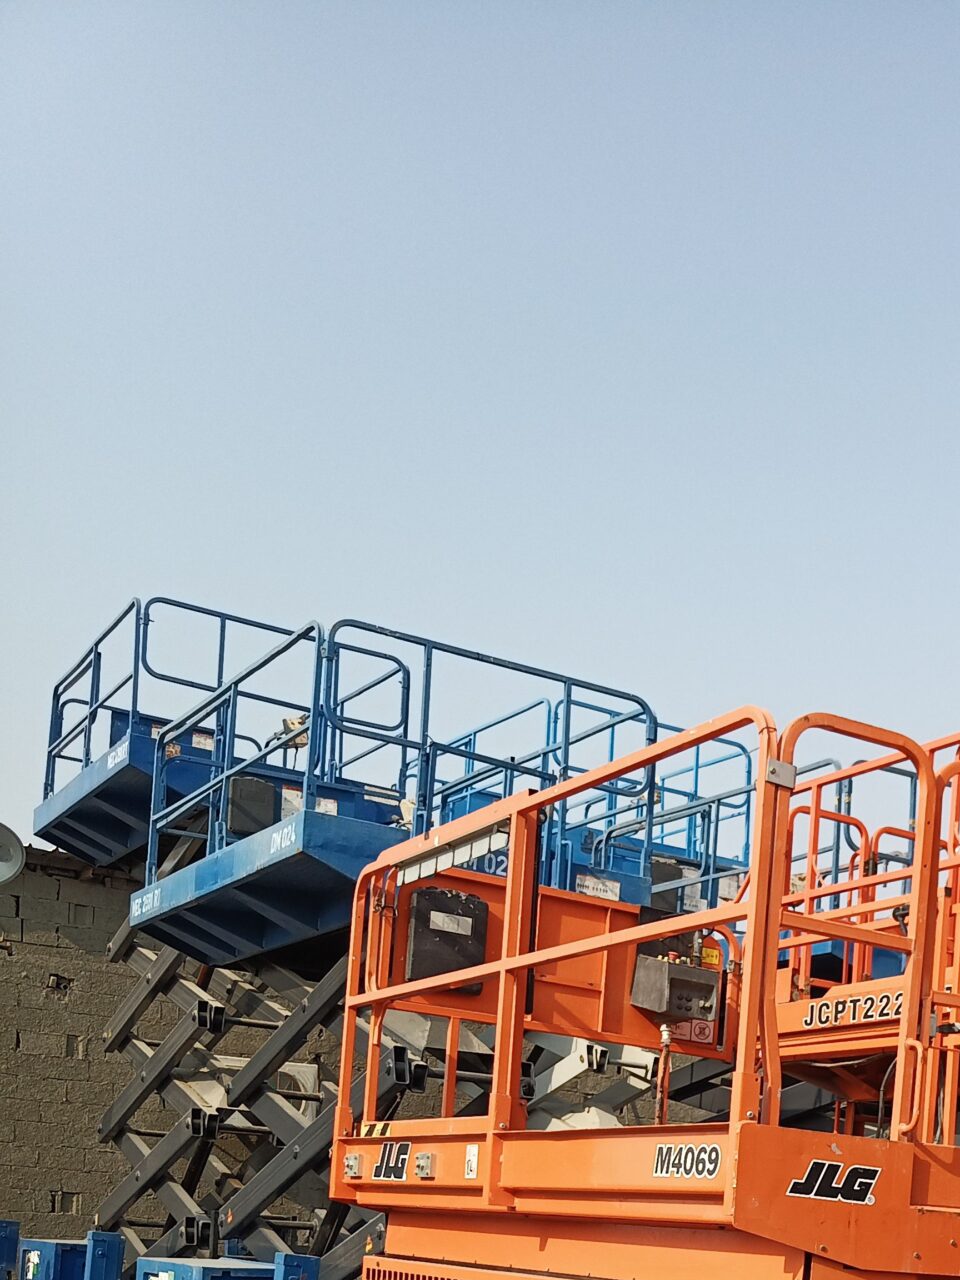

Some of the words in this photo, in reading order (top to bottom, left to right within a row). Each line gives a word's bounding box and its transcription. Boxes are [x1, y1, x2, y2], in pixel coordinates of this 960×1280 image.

[484, 853, 507, 876] 02
[804, 992, 904, 1028] JCPT222
[372, 1142, 411, 1180] JLG
[655, 1146, 720, 1177] M4069
[787, 1160, 882, 1203] JLG
